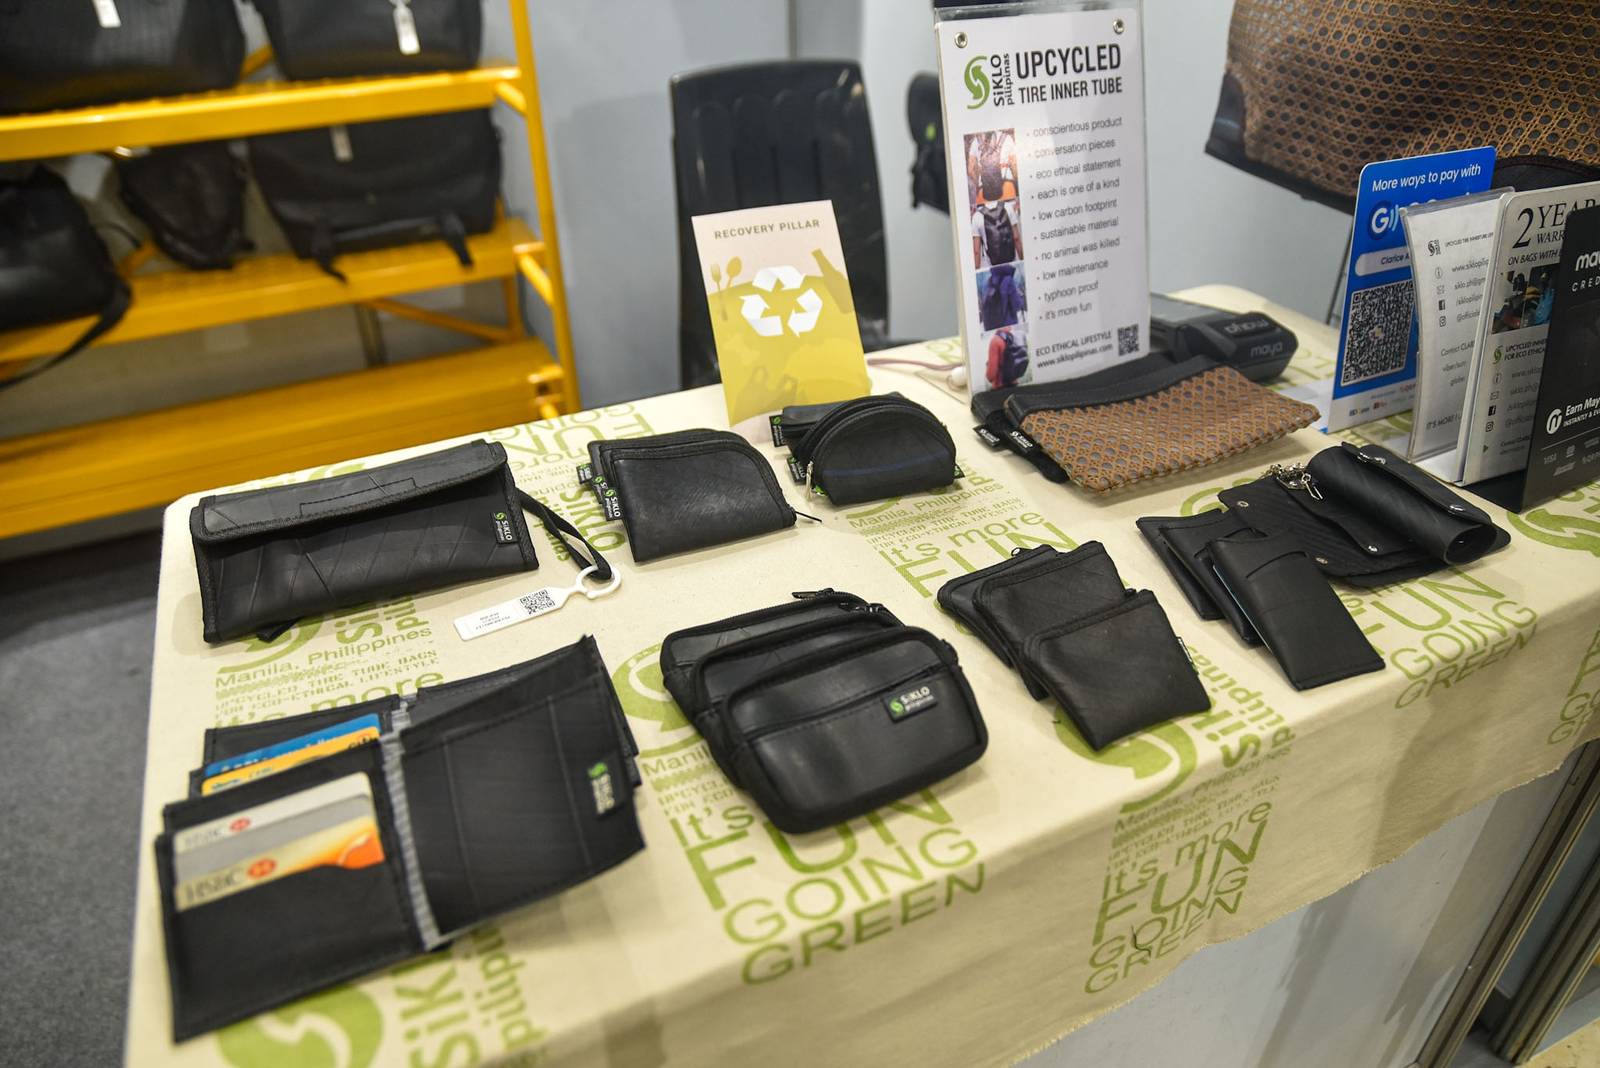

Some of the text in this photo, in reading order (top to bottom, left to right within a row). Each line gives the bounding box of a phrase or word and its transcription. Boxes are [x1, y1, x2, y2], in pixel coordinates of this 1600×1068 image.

[1015, 43, 1122, 80] UPCYCLED
[1003, 53, 1016, 106] pilipinas
[1018, 77, 1123, 104] TIRE INNER TUBE
[1033, 117, 1122, 137] conscientious product
[1034, 139, 1116, 159] conversation pieces
[1036, 158, 1122, 179] eco ethical statement
[1372, 163, 1481, 193] More ways to pay with
[1037, 177, 1120, 200] each is one of a kind
[1038, 199, 1118, 221] low carbon footprint
[714, 218, 821, 240] RECOVERY PILLAR
[1040, 216, 1119, 240] sustainable material
[1512, 207, 1535, 249] 2
[1041, 237, 1120, 261] no animal was killed
[1507, 249, 1558, 266] ON BAGS WITH
[1042, 260, 1109, 281] low maintenance
[1044, 280, 1099, 303] typhoon proof
[1057, 305, 1078, 317] more
[1079, 302, 1092, 313] fun
[1035, 329, 1112, 357] ECO ETHICAL LIFESTYLE
[1566, 403, 1583, 417] Earn
[913, 481, 1004, 512] Philippines
[879, 542, 941, 567] It's
[947, 512, 1045, 548] more
[308, 627, 433, 665] Philippines
[1389, 600, 1538, 681] GOING
[1395, 623, 1538, 709] GREEN
[669, 805, 755, 848] It's
[1174, 801, 1272, 867] more
[722, 827, 979, 945] GOING
[1092, 818, 1268, 946] FUN
[741, 862, 986, 986] GREEN
[1088, 866, 1249, 968] GOING
[1084, 891, 1243, 994] GREEN
